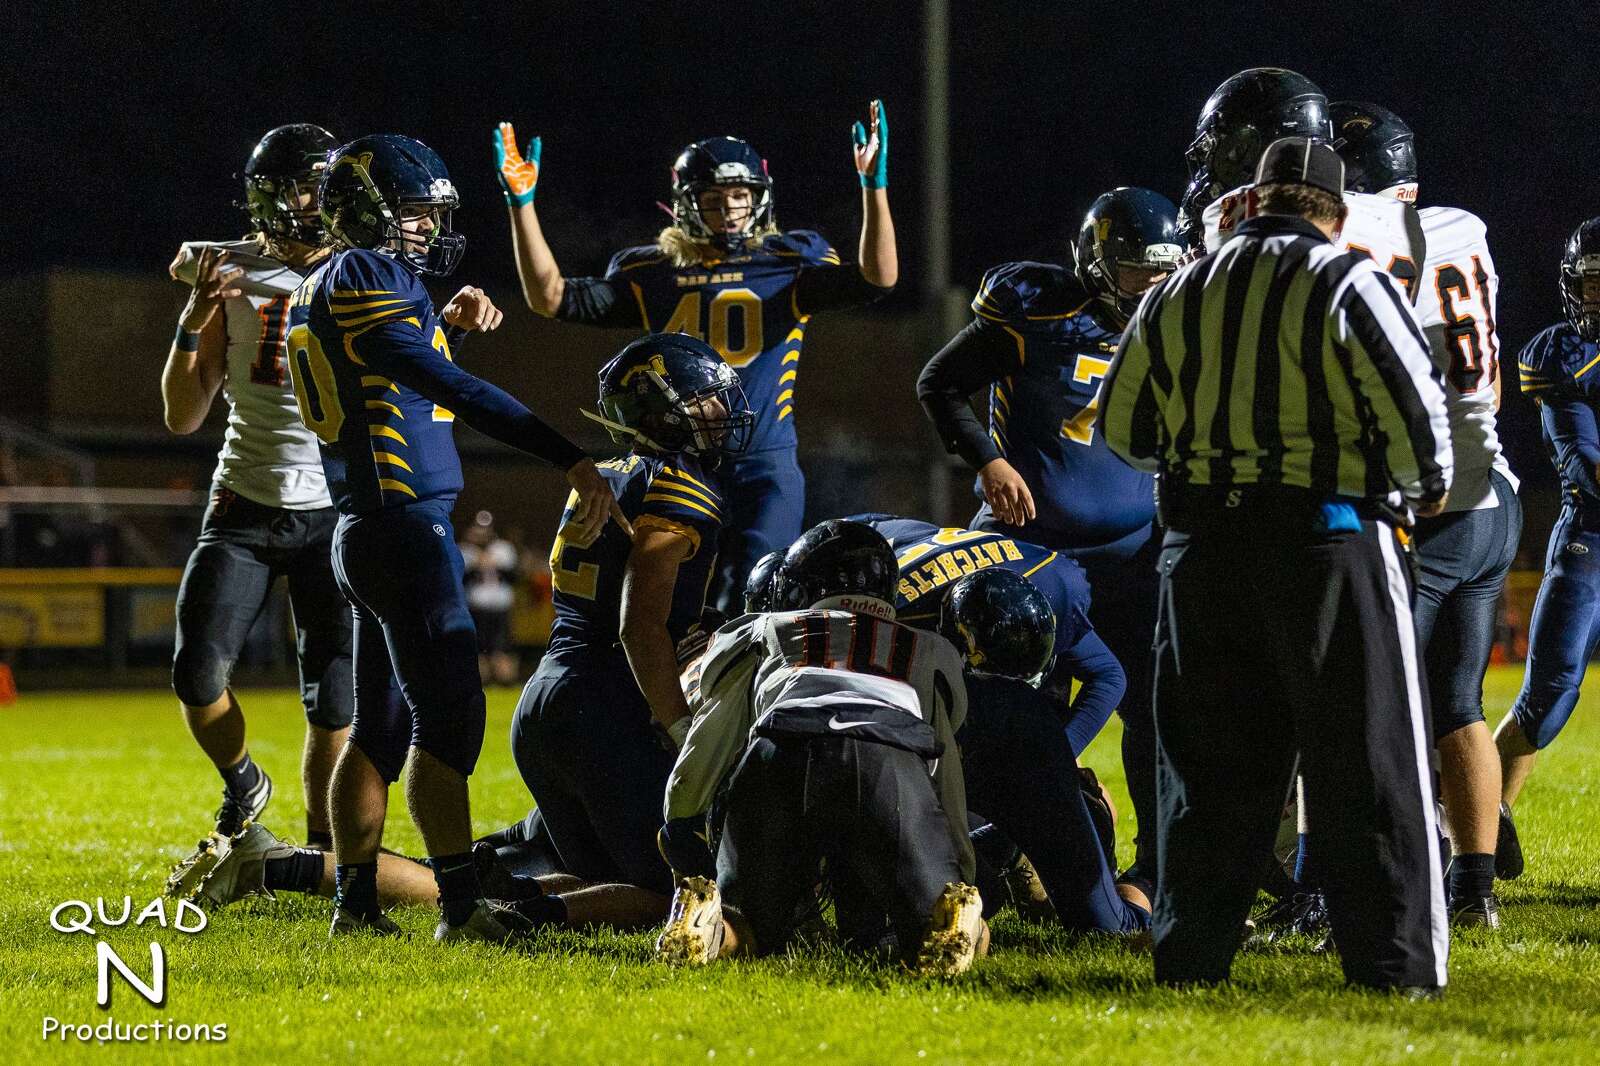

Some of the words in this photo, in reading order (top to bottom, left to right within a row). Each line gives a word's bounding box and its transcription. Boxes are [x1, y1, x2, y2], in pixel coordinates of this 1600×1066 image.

[664, 287, 764, 368] 40
[1433, 254, 1498, 393] 61
[1225, 489, 1241, 509] S
[898, 539, 1024, 603] HATCHETS
